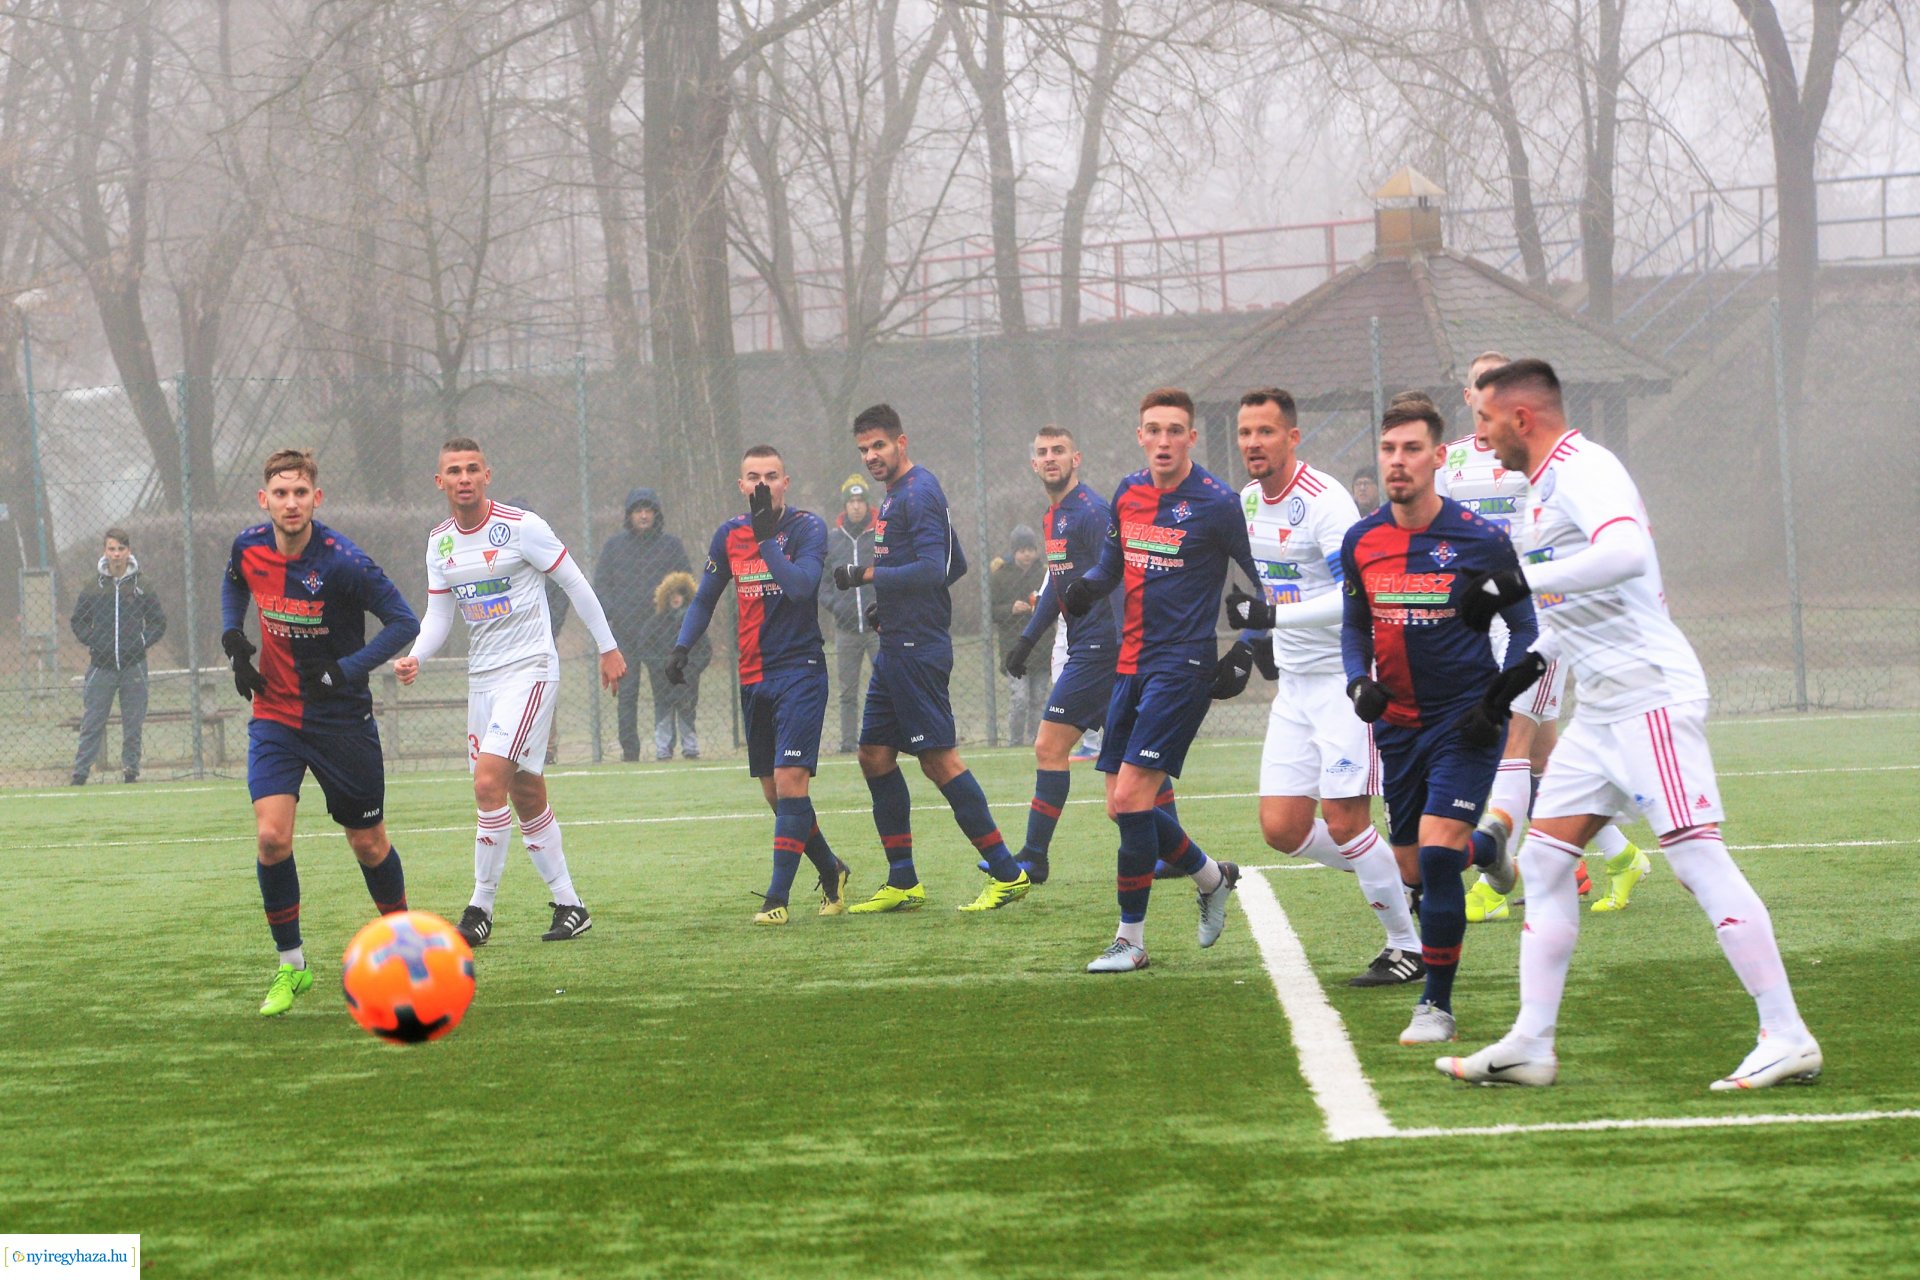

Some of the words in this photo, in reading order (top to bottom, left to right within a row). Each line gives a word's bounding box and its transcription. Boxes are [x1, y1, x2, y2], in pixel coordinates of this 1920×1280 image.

[1120, 522, 1187, 547] REVESZ
[1365, 573, 1456, 594] REVESZ
[1049, 705, 1065, 714] JAKO
[1139, 749, 1160, 759] JAKO
[1452, 798, 1476, 811] JAKO
[362, 808, 380, 818] JAKO
